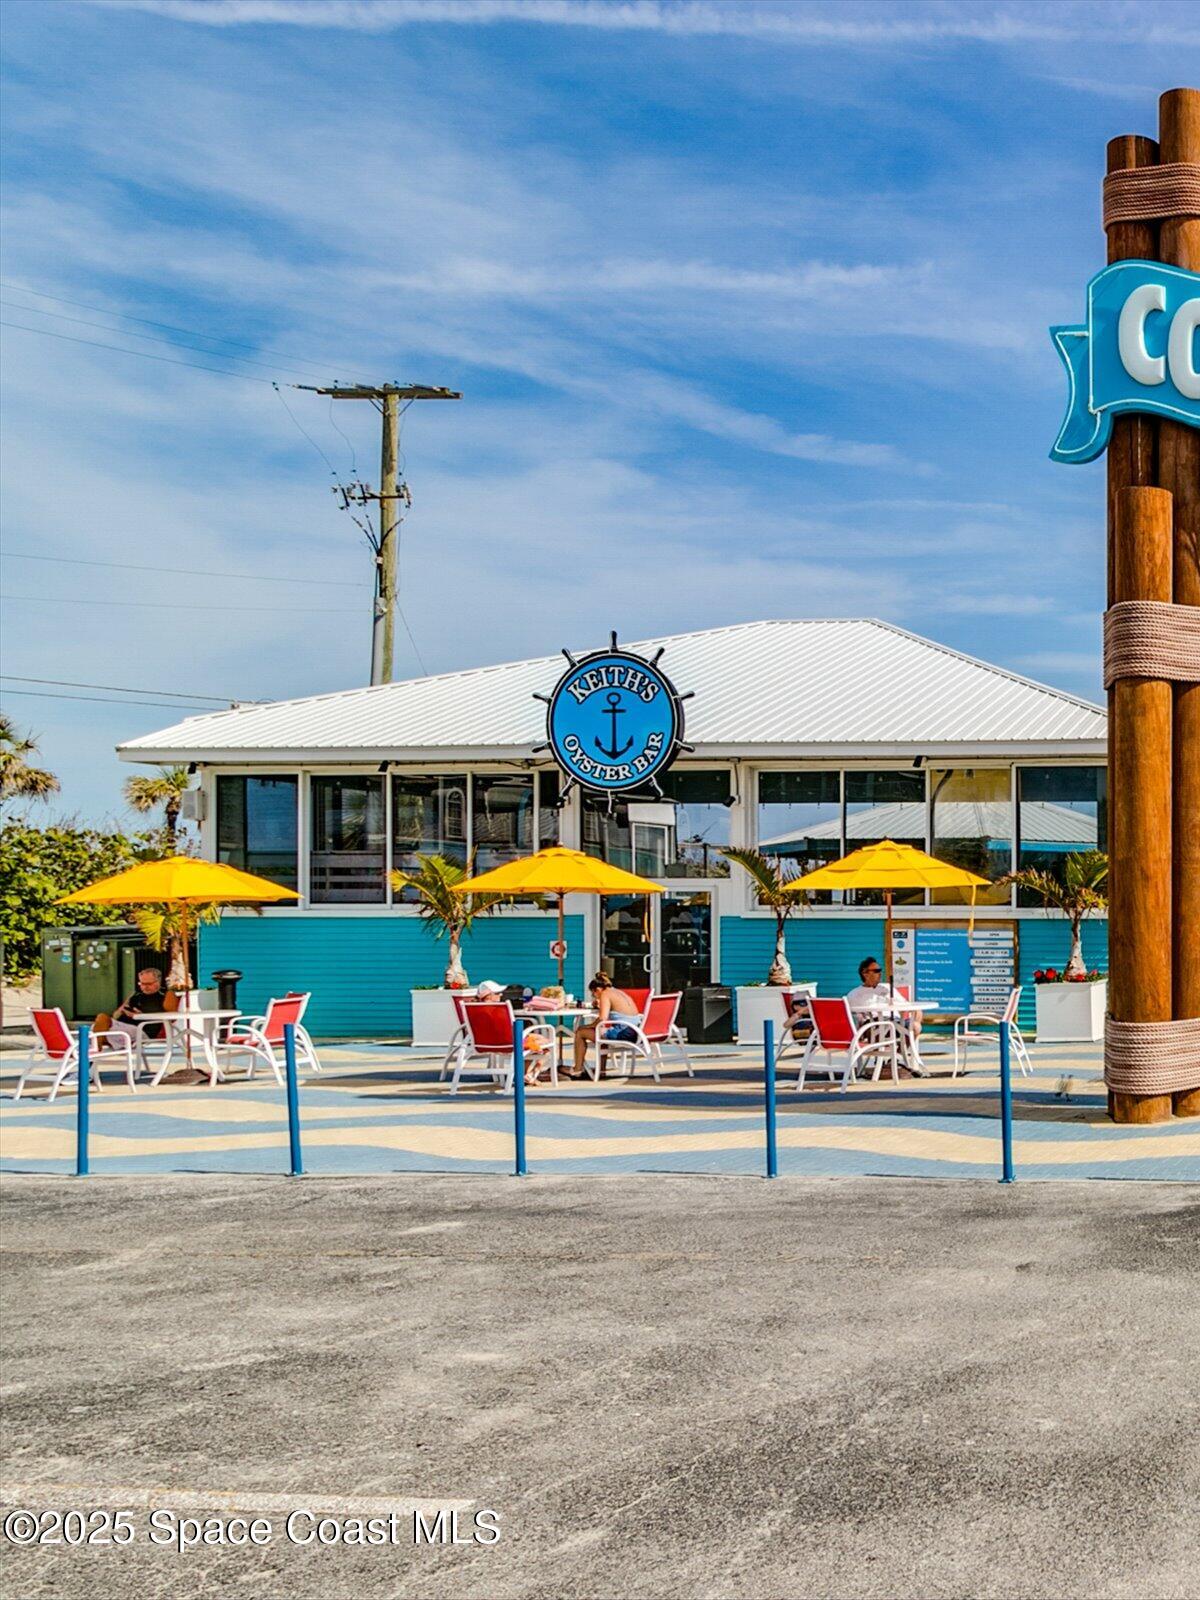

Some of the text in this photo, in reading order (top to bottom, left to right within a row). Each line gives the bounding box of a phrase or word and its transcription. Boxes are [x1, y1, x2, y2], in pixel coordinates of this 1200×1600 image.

[567, 666, 660, 703] KEITH'S
[564, 732, 665, 781] OYSTER BAR
